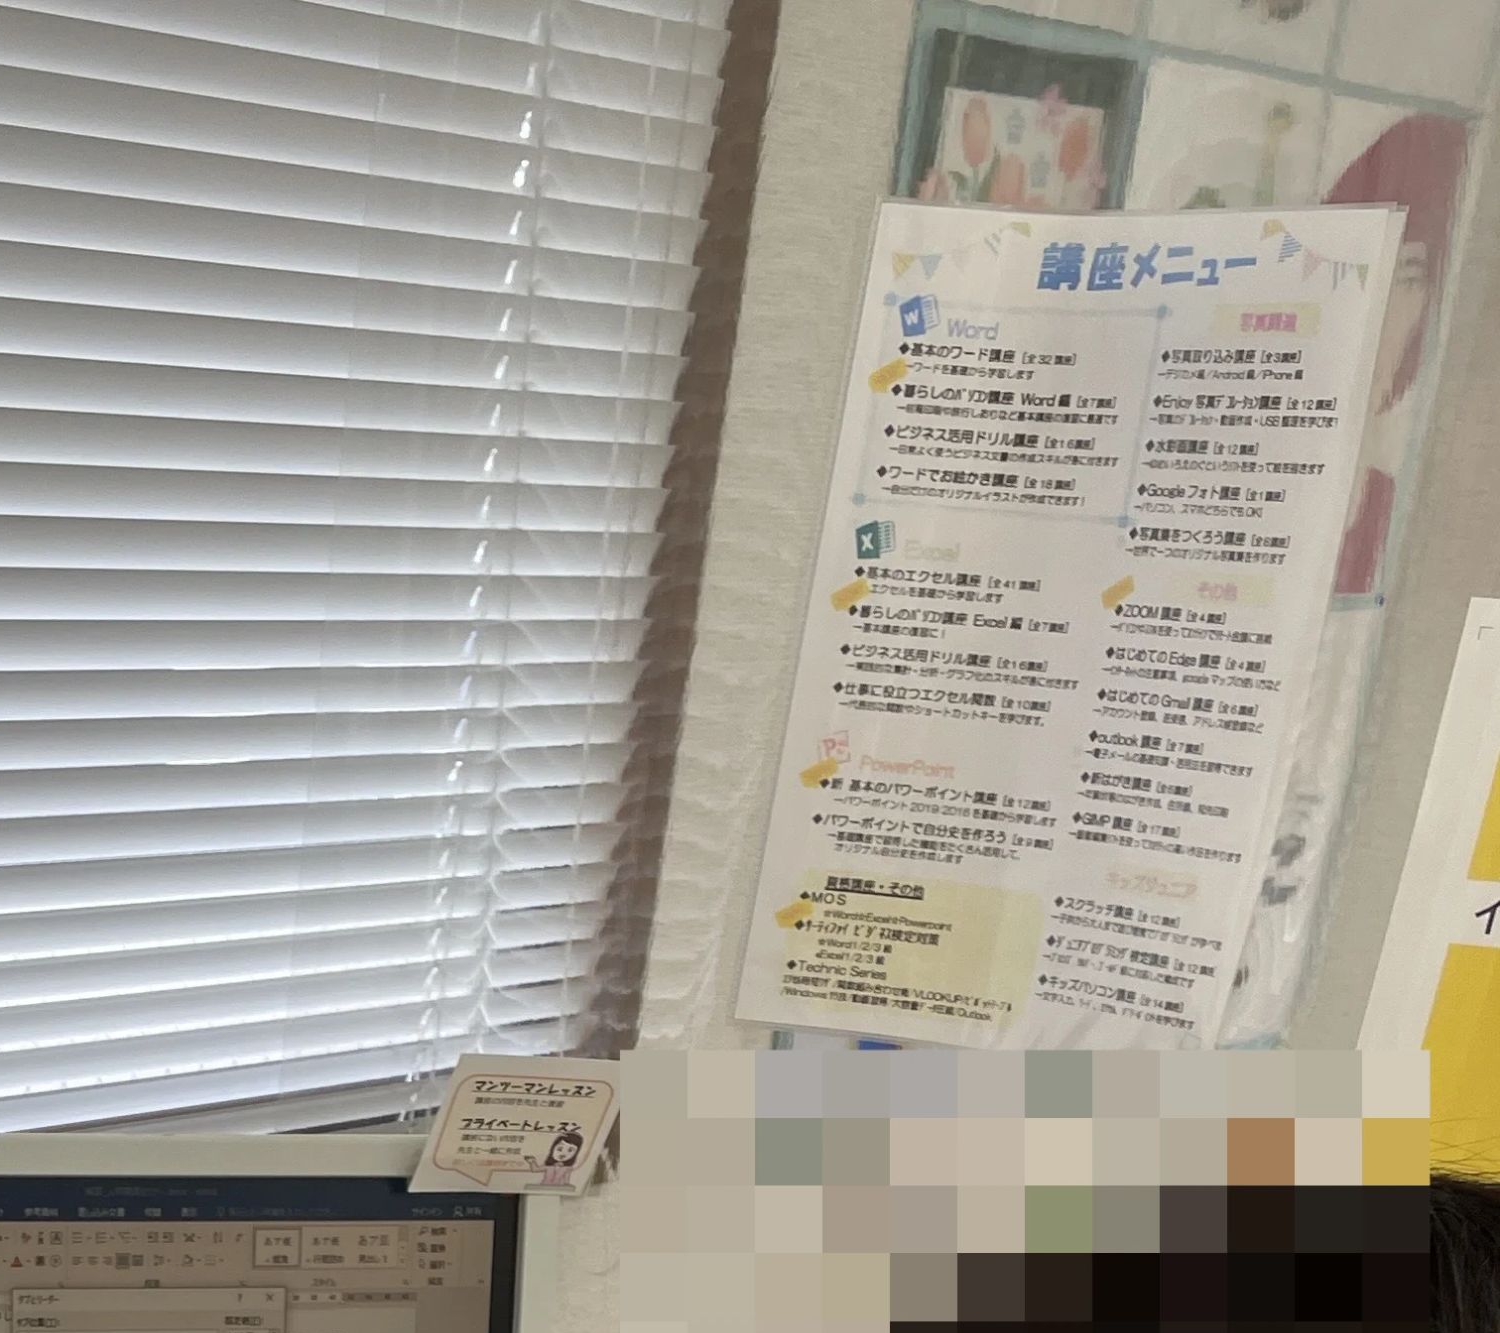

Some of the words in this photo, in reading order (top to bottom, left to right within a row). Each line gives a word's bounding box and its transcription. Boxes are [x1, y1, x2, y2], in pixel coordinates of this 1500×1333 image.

[1037, 242, 1257, 291] 講座メニュー
[947, 317, 999, 341] Word
[910, 342, 1016, 364] 基本のワード講座
[1171, 349, 1256, 364] 写真取り込み講座
[1021, 396, 1056, 410] Word
[1161, 394, 1193, 411] Enjoy
[896, 424, 1039, 449] ビジネス活用ドリル講座
[888, 465, 1020, 489] ワードでお絵かき講座
[1147, 484, 1186, 499] Google
[1187, 485, 1242, 501] フォト講座
[1139, 526, 1247, 547] 写真集をつくろう講座
[904, 539, 961, 562] Excel
[866, 566, 982, 589] 基本のエクセル講座
[973, 613, 1009, 630] Excel
[1123, 603, 1160, 619] ZOOM
[851, 643, 992, 669] ビジネス活用ドリル講座
[1168, 651, 1198, 668] Edge
[1161, 694, 1192, 711] Gmail
[858, 754, 956, 780] PowerPoint
[849, 777, 998, 806] 基本のパワーポイント講座
[823, 813, 1007, 844] パワーポイントで自分史を作ろう
[810, 891, 847, 906] MOS
[1063, 896, 1135, 921] スクラッチ講座
[797, 959, 847, 977] Technic
[849, 964, 888, 981] Series
[474, 1079, 597, 1097] マンツーマンレッスン
[461, 1117, 583, 1134] プライベートレッスン
